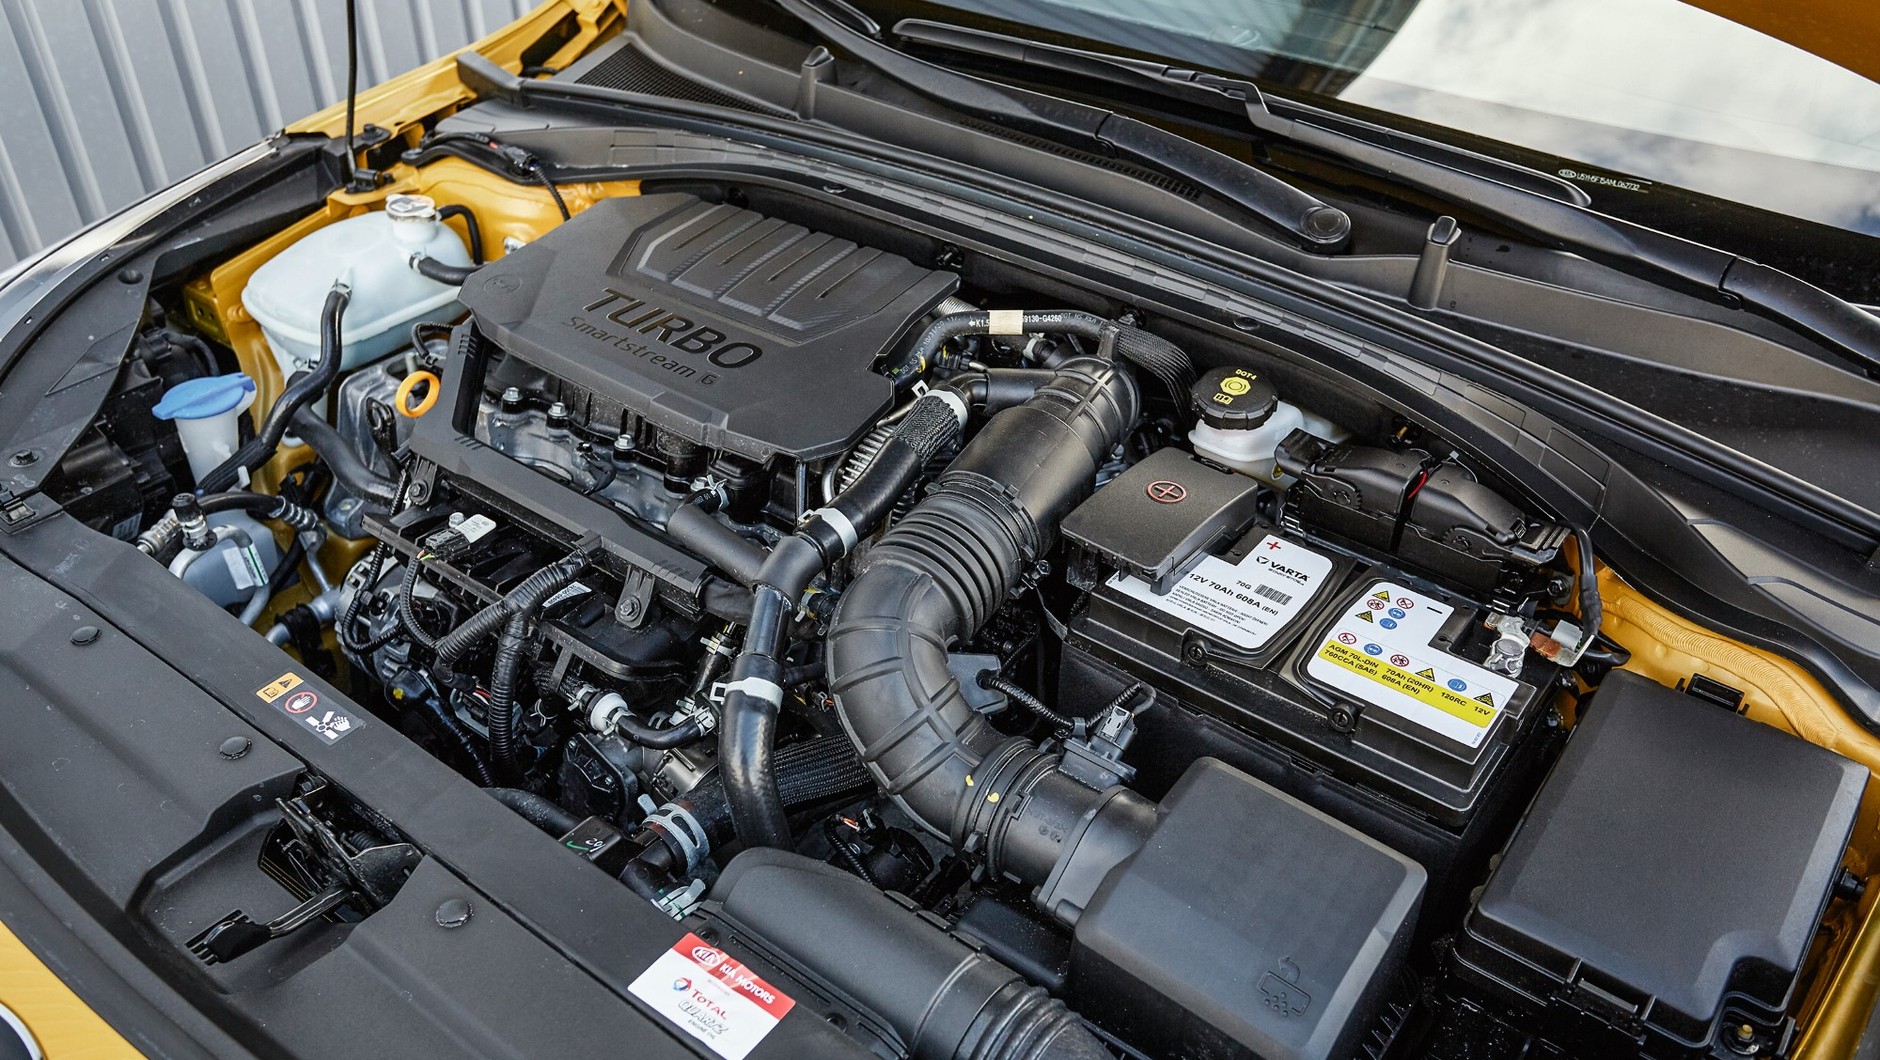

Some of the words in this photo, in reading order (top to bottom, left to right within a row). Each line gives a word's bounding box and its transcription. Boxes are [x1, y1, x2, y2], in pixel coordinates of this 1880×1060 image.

[582, 287, 764, 369] TURBO
[562, 316, 697, 379] Smartstream
[701, 371, 721, 387] G
[1235, 369, 1257, 380] DOT4
[1236, 580, 1252, 590] 70G
[1271, 561, 1309, 582] VARTA
[1189, 573, 1209, 584] 12V
[1209, 582, 1234, 596] 70Ah
[1235, 593, 1261, 608] 608A
[1261, 604, 1279, 616] (EN)
[1324, 649, 1354, 667] 760CCA
[1354, 663, 1377, 676] (SAE)
[1381, 675, 1401, 687] 608A
[1402, 682, 1420, 695] (EN)
[1328, 644, 1348, 656] AGM
[1349, 652, 1379, 668] 70L-DIN
[1386, 668, 1406, 681] 70Ah
[1407, 676, 1434, 692] (20HR)
[1441, 691, 1467, 707] 120RC
[1474, 706, 1491, 716] 12V
[692, 946, 720, 966] KIA
[691, 989, 728, 1020] TOTAL
[719, 962, 736, 979] KIA
[735, 975, 776, 1005] MOTORS
